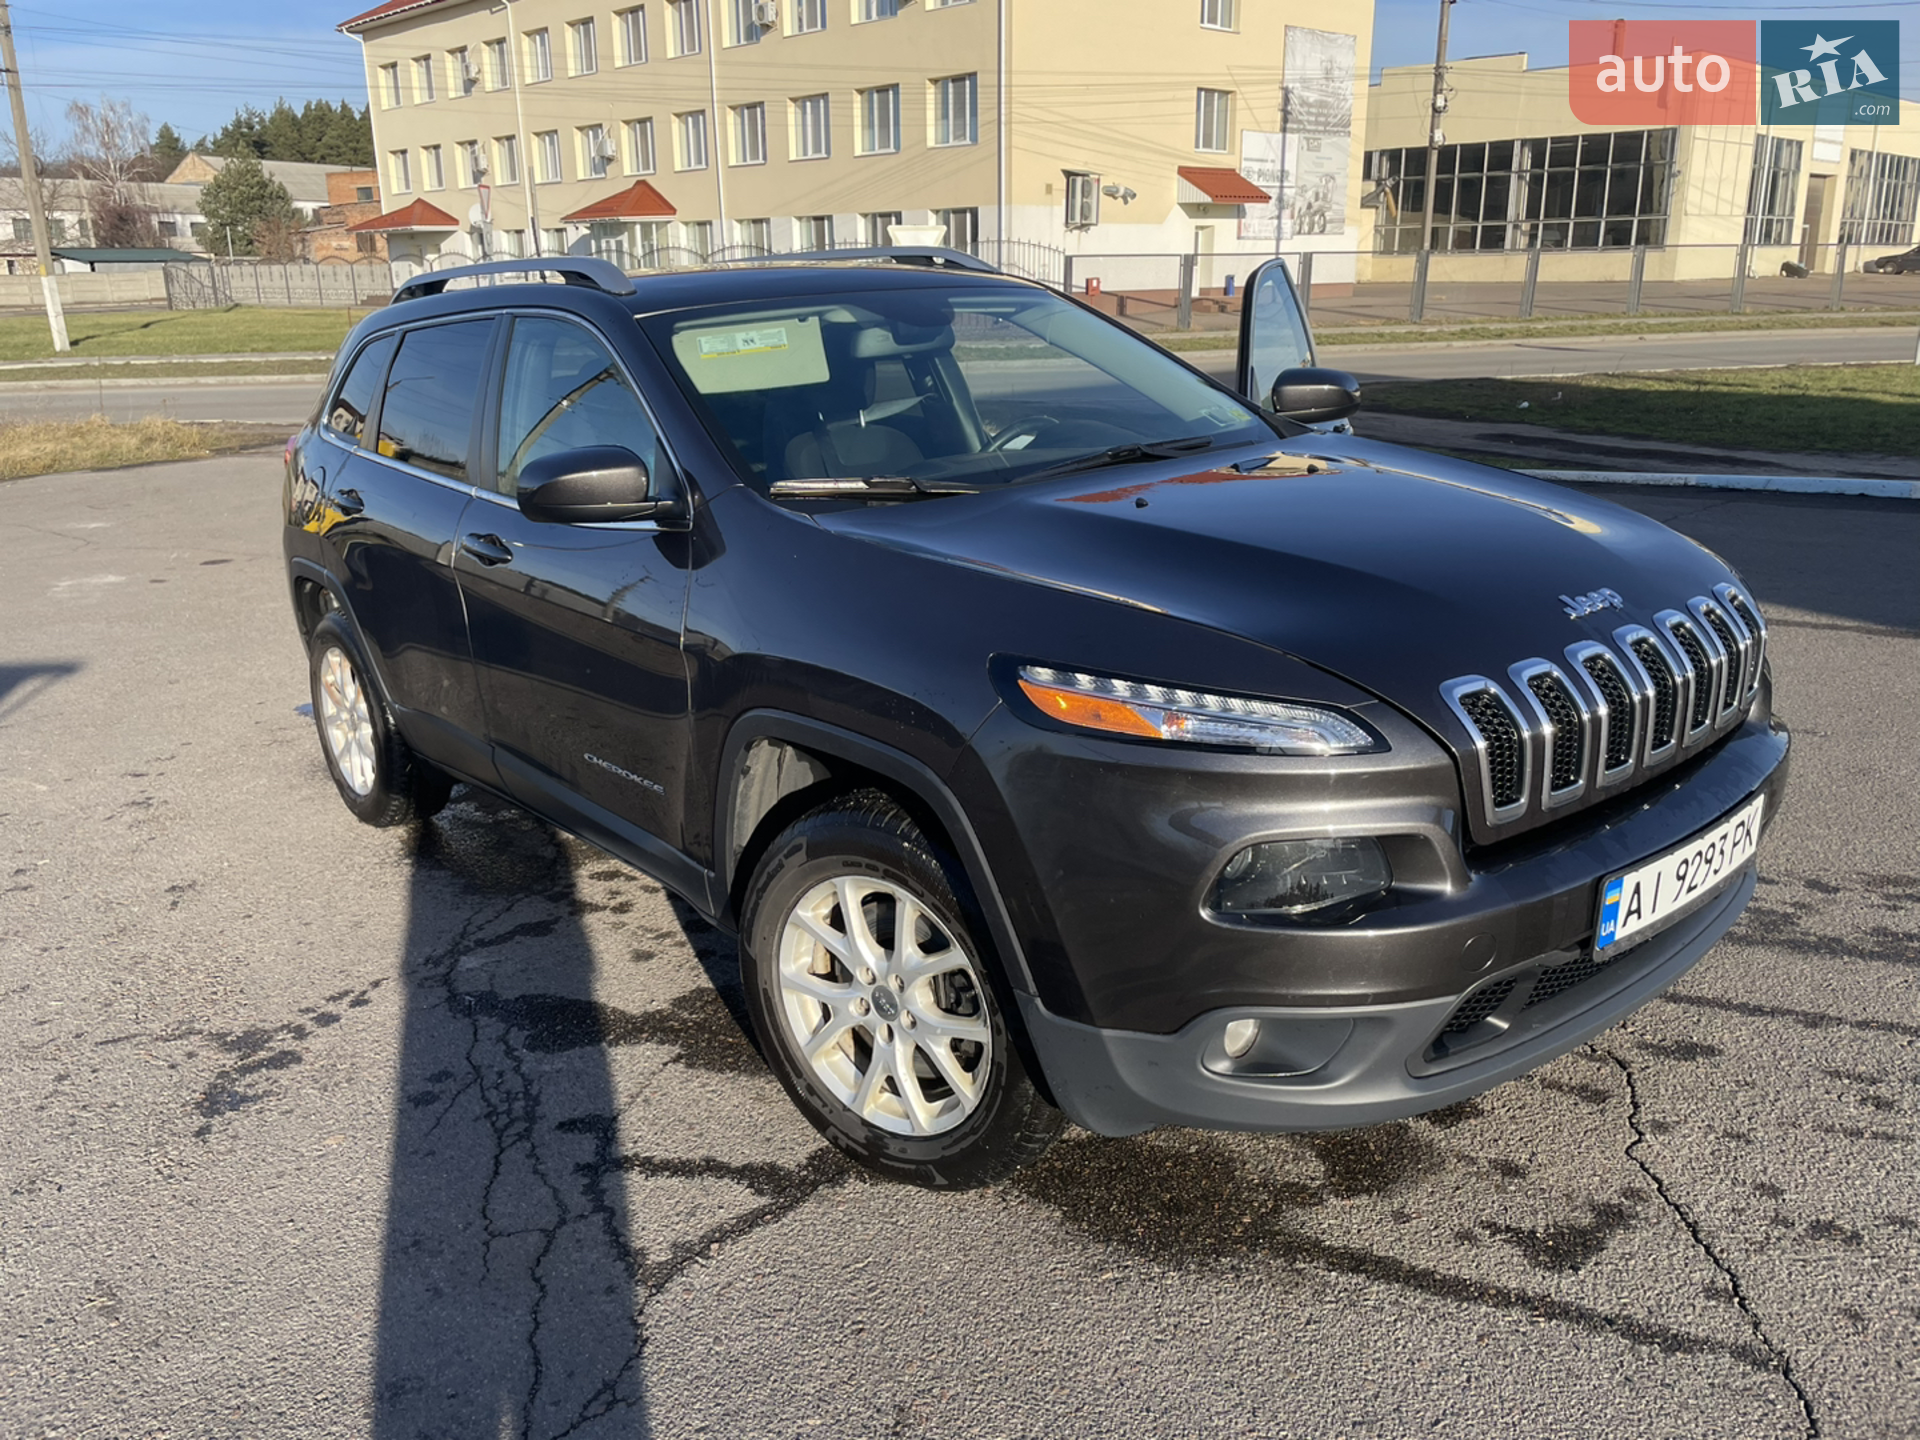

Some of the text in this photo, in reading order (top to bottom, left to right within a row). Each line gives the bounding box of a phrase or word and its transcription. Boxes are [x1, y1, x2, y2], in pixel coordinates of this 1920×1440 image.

[1558, 587, 1624, 620] Jeep
[1621, 807, 1759, 928] AI 9293 PK
[1601, 920, 1617, 937] UA
